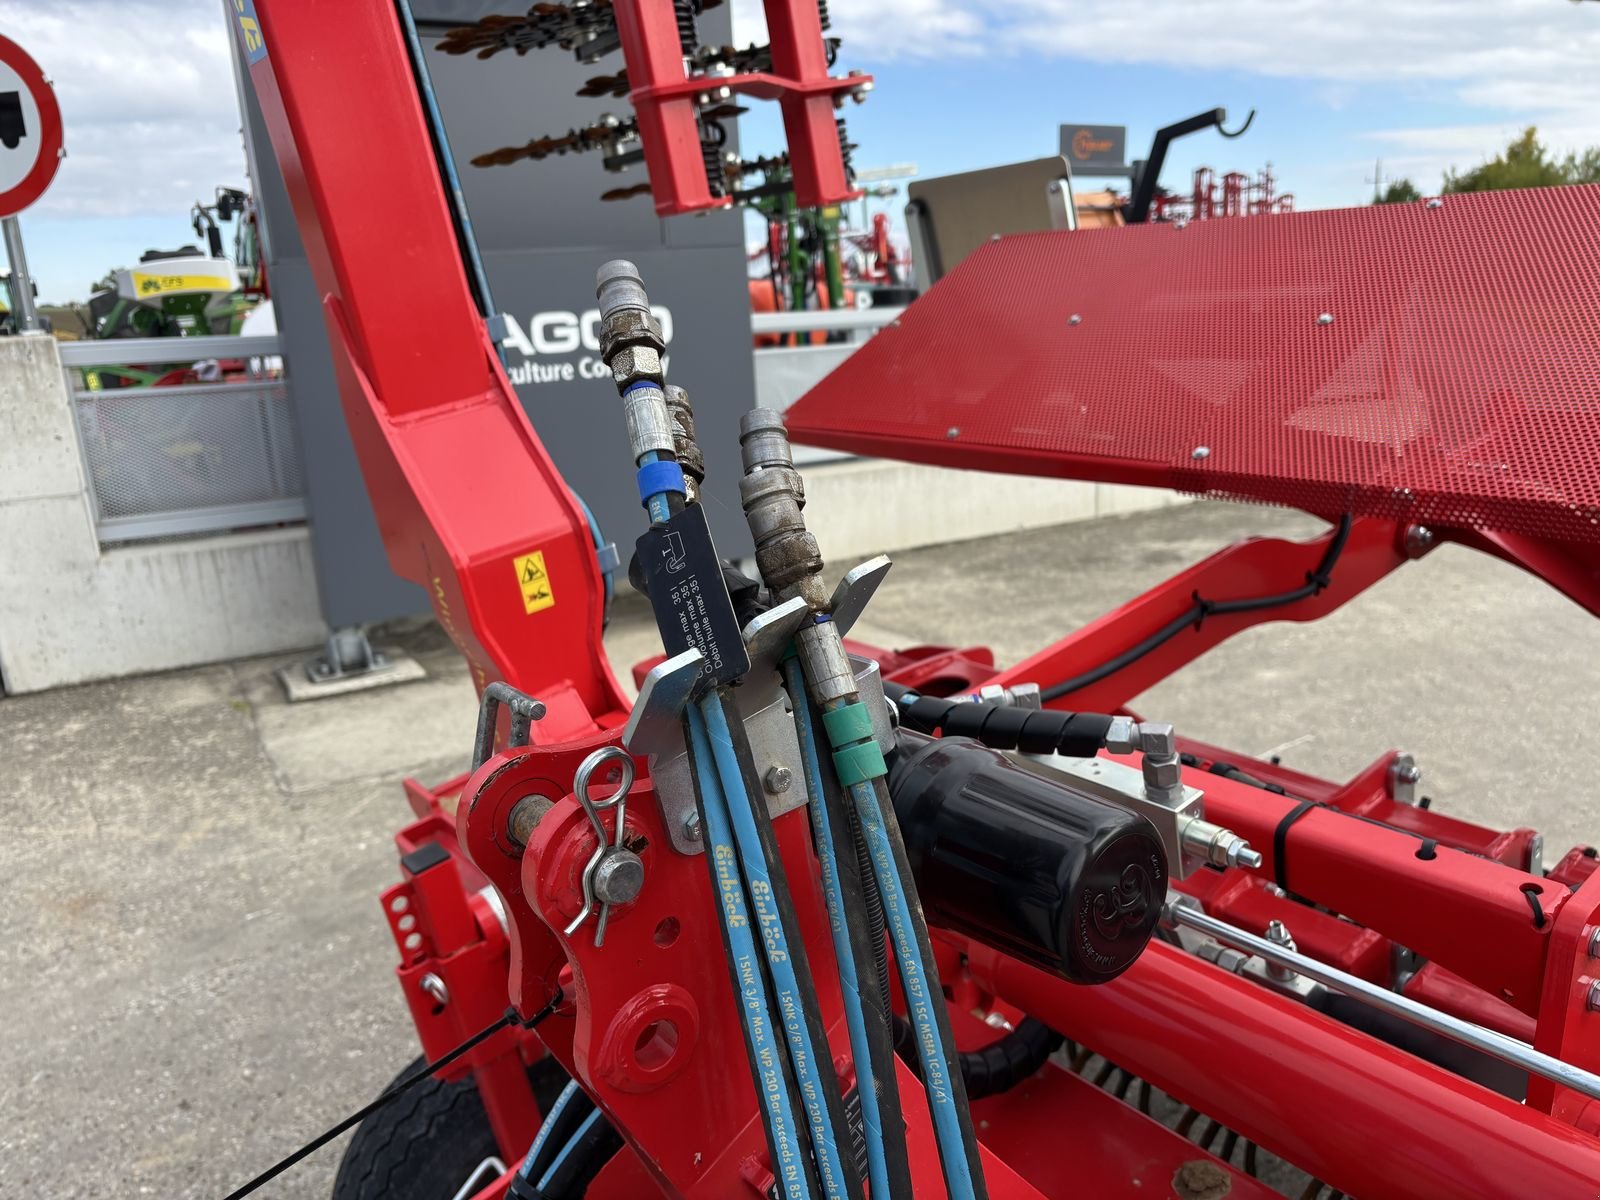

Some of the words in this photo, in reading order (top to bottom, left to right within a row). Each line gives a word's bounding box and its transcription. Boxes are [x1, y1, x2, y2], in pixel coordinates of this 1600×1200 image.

[672, 591, 681, 604] 35
[681, 585, 690, 599] 35
[690, 580, 699, 593] 35
[686, 599, 698, 620] max
[695, 593, 706, 616] max
[679, 611, 690, 632] max
[702, 617, 714, 641] huile
[692, 622, 708, 658] volume
[709, 641, 723, 669] Débit
[821, 853, 832, 885] MSHA
[876, 851, 888, 869] WP
[716, 844, 746, 928] Einböck
[881, 871, 895, 892] 230
[888, 892, 898, 912] Bar
[752, 880, 787, 963] Einböck
[893, 914, 912, 961] exceeds
[905, 959, 916, 975] EN
[908, 977, 923, 998] 857
[745, 988, 760, 1013] 3/8"
[752, 1016, 764, 1046] Max.
[788, 1023, 803, 1047] 3/8"
[920, 1024, 935, 1056] MSHA
[760, 1047, 772, 1067] WP
[795, 1050, 807, 1079] Max.
[764, 1070, 779, 1092] 230
[802, 1081, 815, 1100] WP
[929, 1056, 947, 1105] IC-84/41
[770, 1093, 781, 1114] Bar
[808, 1103, 822, 1123] 230
[775, 1117, 794, 1163] exceeds
[815, 1126, 824, 1149] Bar
[785, 1165, 798, 1181] EN
[819, 1148, 839, 1193] exceeds
[789, 1184, 802, 1200] 85
